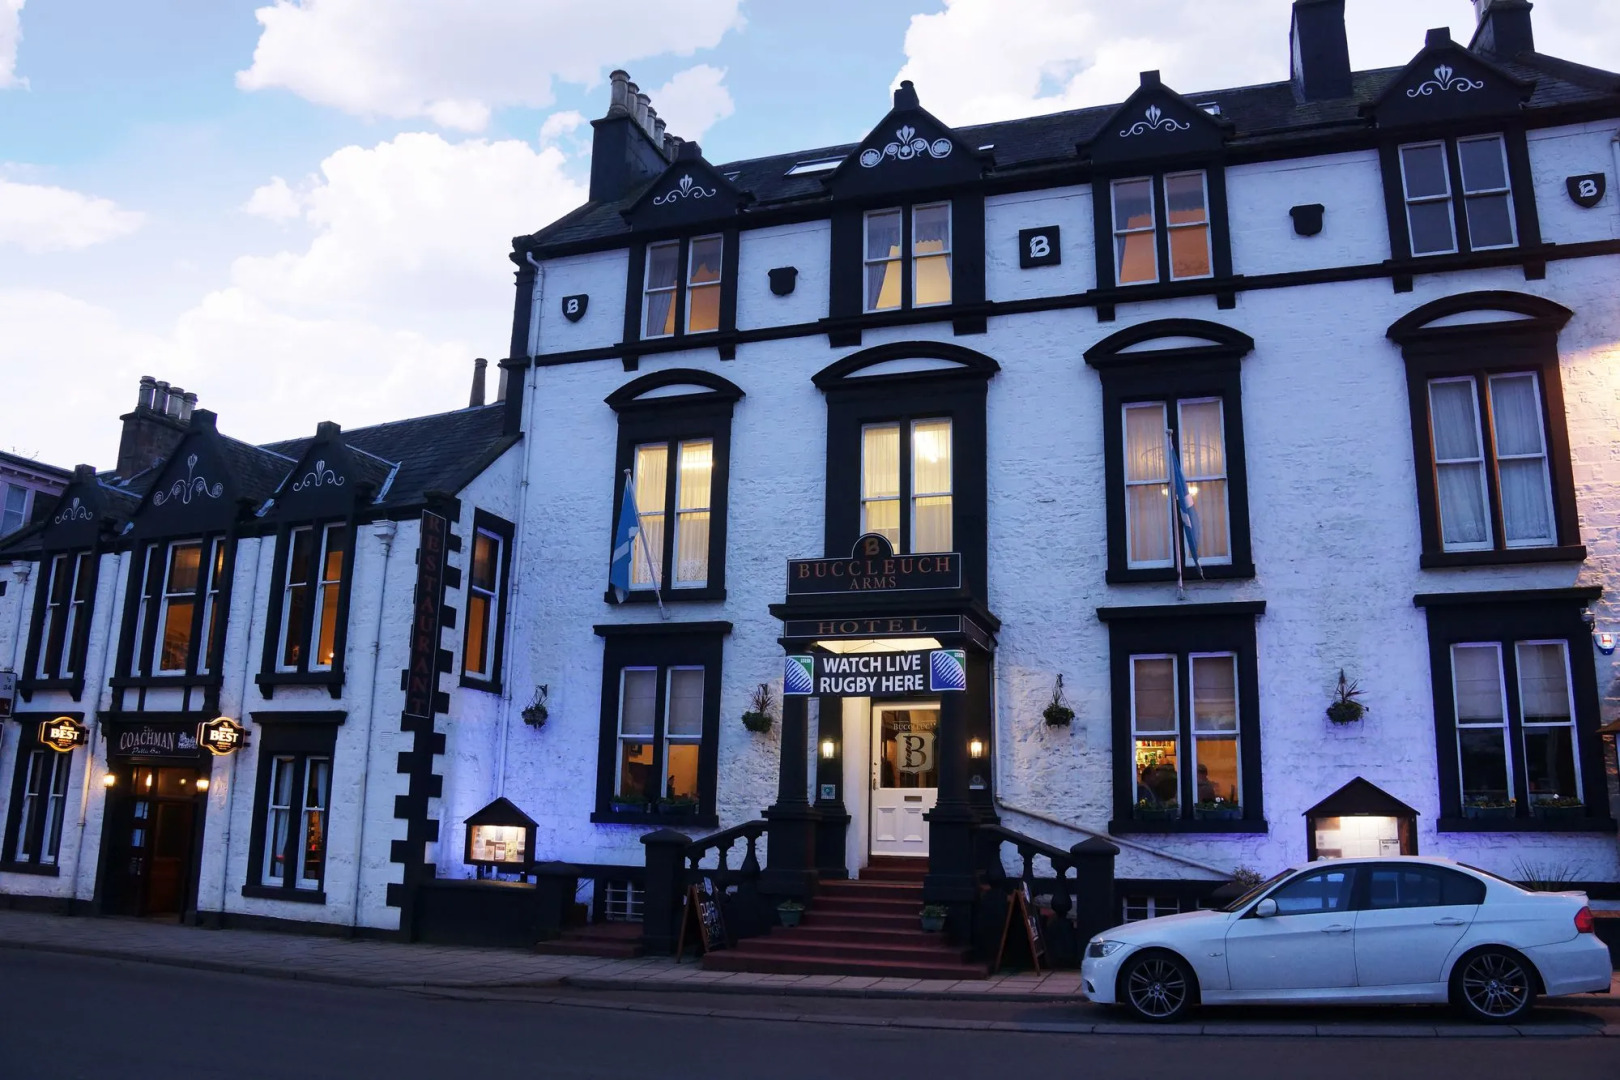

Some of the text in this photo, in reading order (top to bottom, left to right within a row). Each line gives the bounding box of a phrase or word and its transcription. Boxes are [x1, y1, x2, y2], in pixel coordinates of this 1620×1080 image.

[1579, 179, 1597, 198] B
[1030, 235, 1050, 258] B
[567, 298, 579, 314] B
[865, 537, 880, 556] B
[798, 556, 951, 579] BUCCLEUCH
[850, 576, 897, 590] ARMS
[411, 516, 441, 714] RESTAURANT
[817, 618, 927, 635] HOTEL
[822, 654, 922, 674] WATCH LIVE
[819, 674, 924, 693] RUGBY HERE
[50, 728, 80, 740] BEST
[120, 731, 176, 752] COACHMAN
[210, 729, 239, 743] BEST
[902, 735, 927, 769] B
